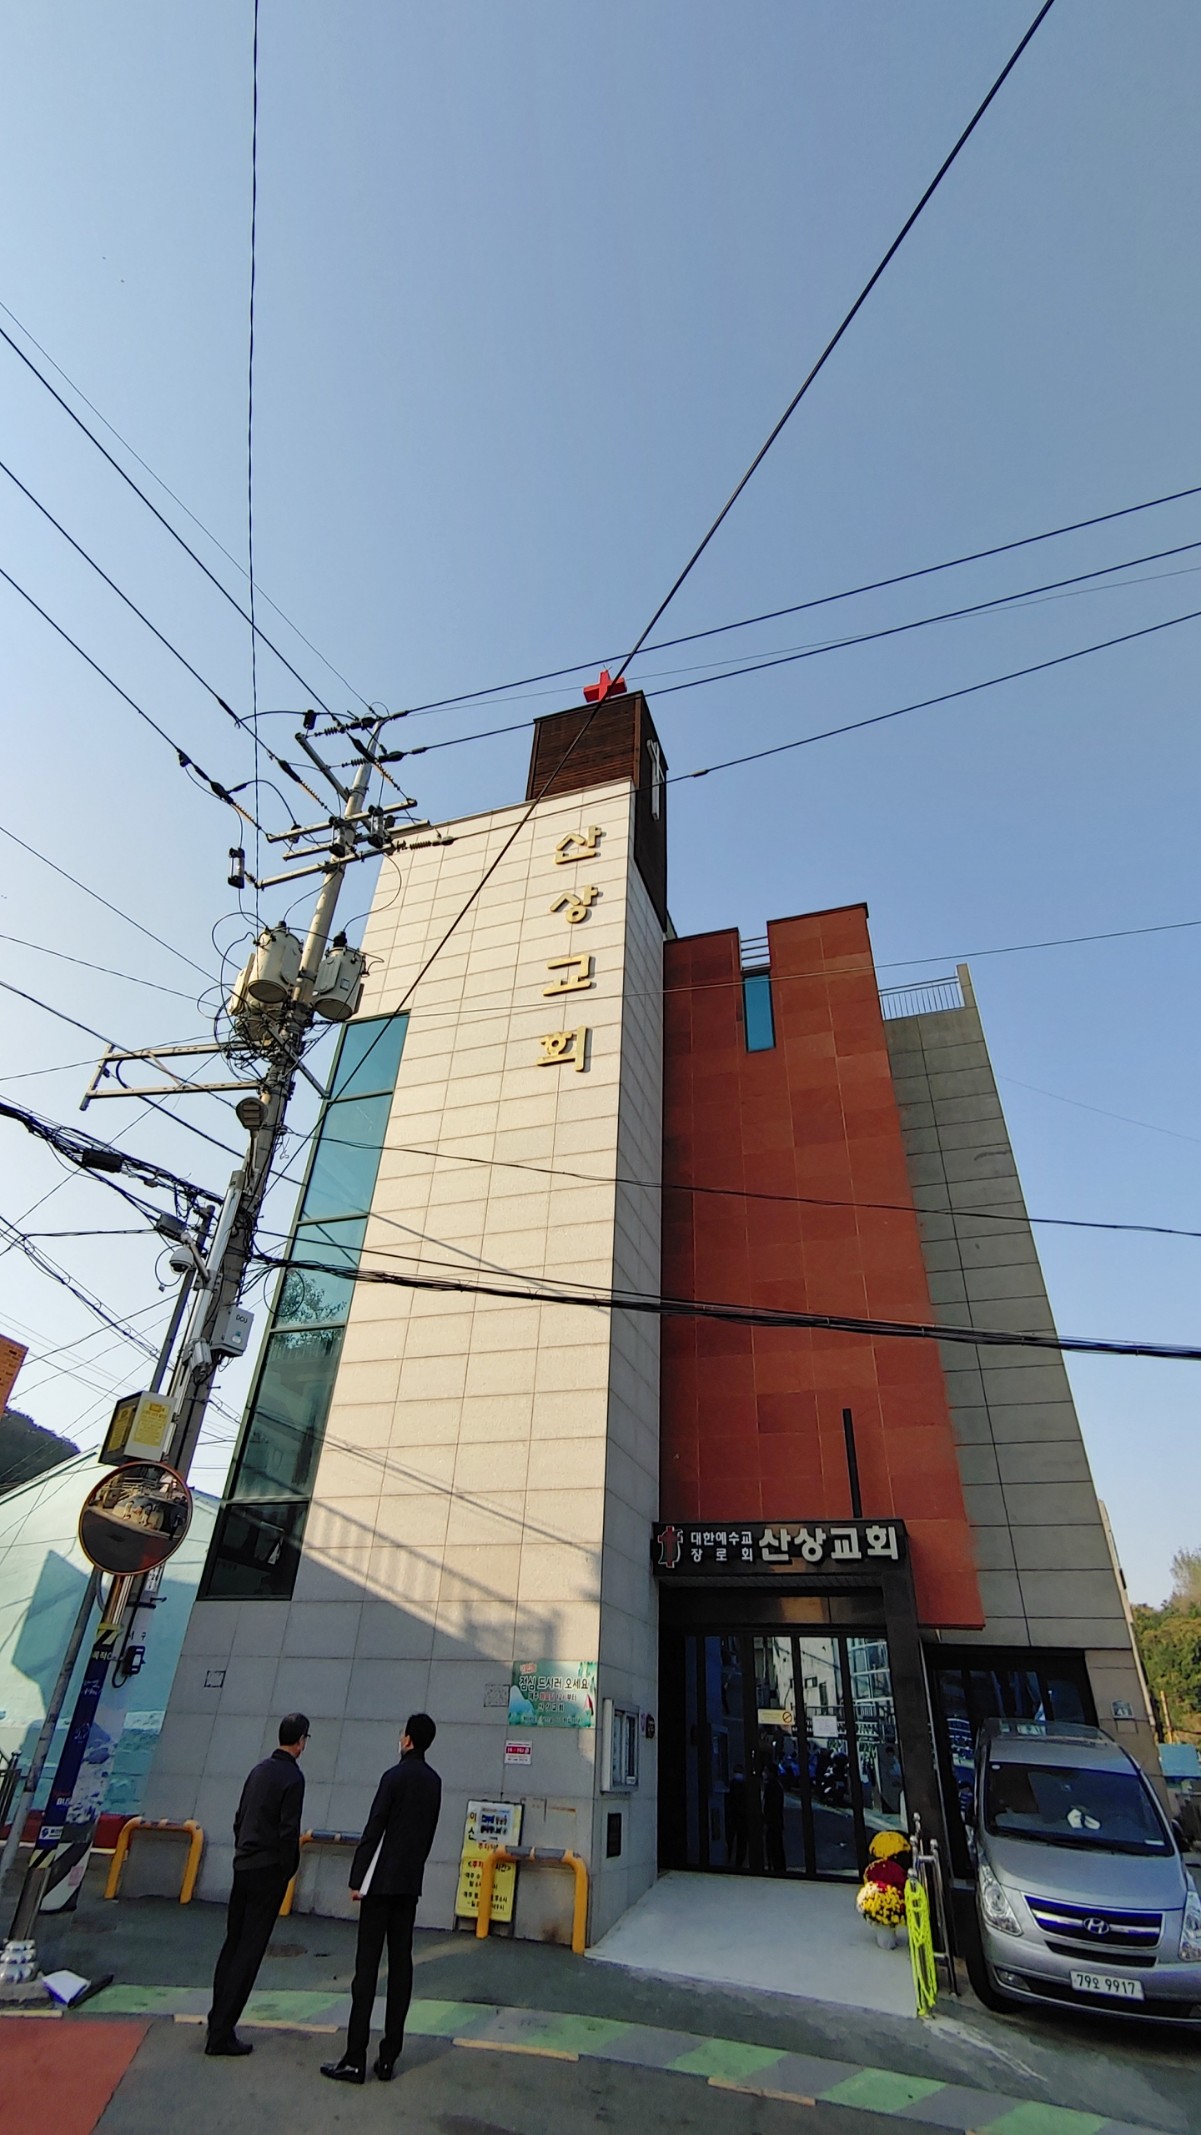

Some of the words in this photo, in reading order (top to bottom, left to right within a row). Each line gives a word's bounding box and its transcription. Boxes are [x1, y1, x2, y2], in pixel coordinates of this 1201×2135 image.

[536, 825, 603, 1073] 산상교회
[690, 1531, 753, 1546] 대한예수교
[758, 1525, 899, 1563] 산상교회
[690, 1548, 753, 1563] 장로회
[519, 1676, 536, 1691] 점심
[537, 1677, 562, 1689] 드시러
[565, 1677, 589, 1690] 오세요
[1076, 1973, 1100, 1990] 79오
[1104, 1978, 1135, 1996] 9917
